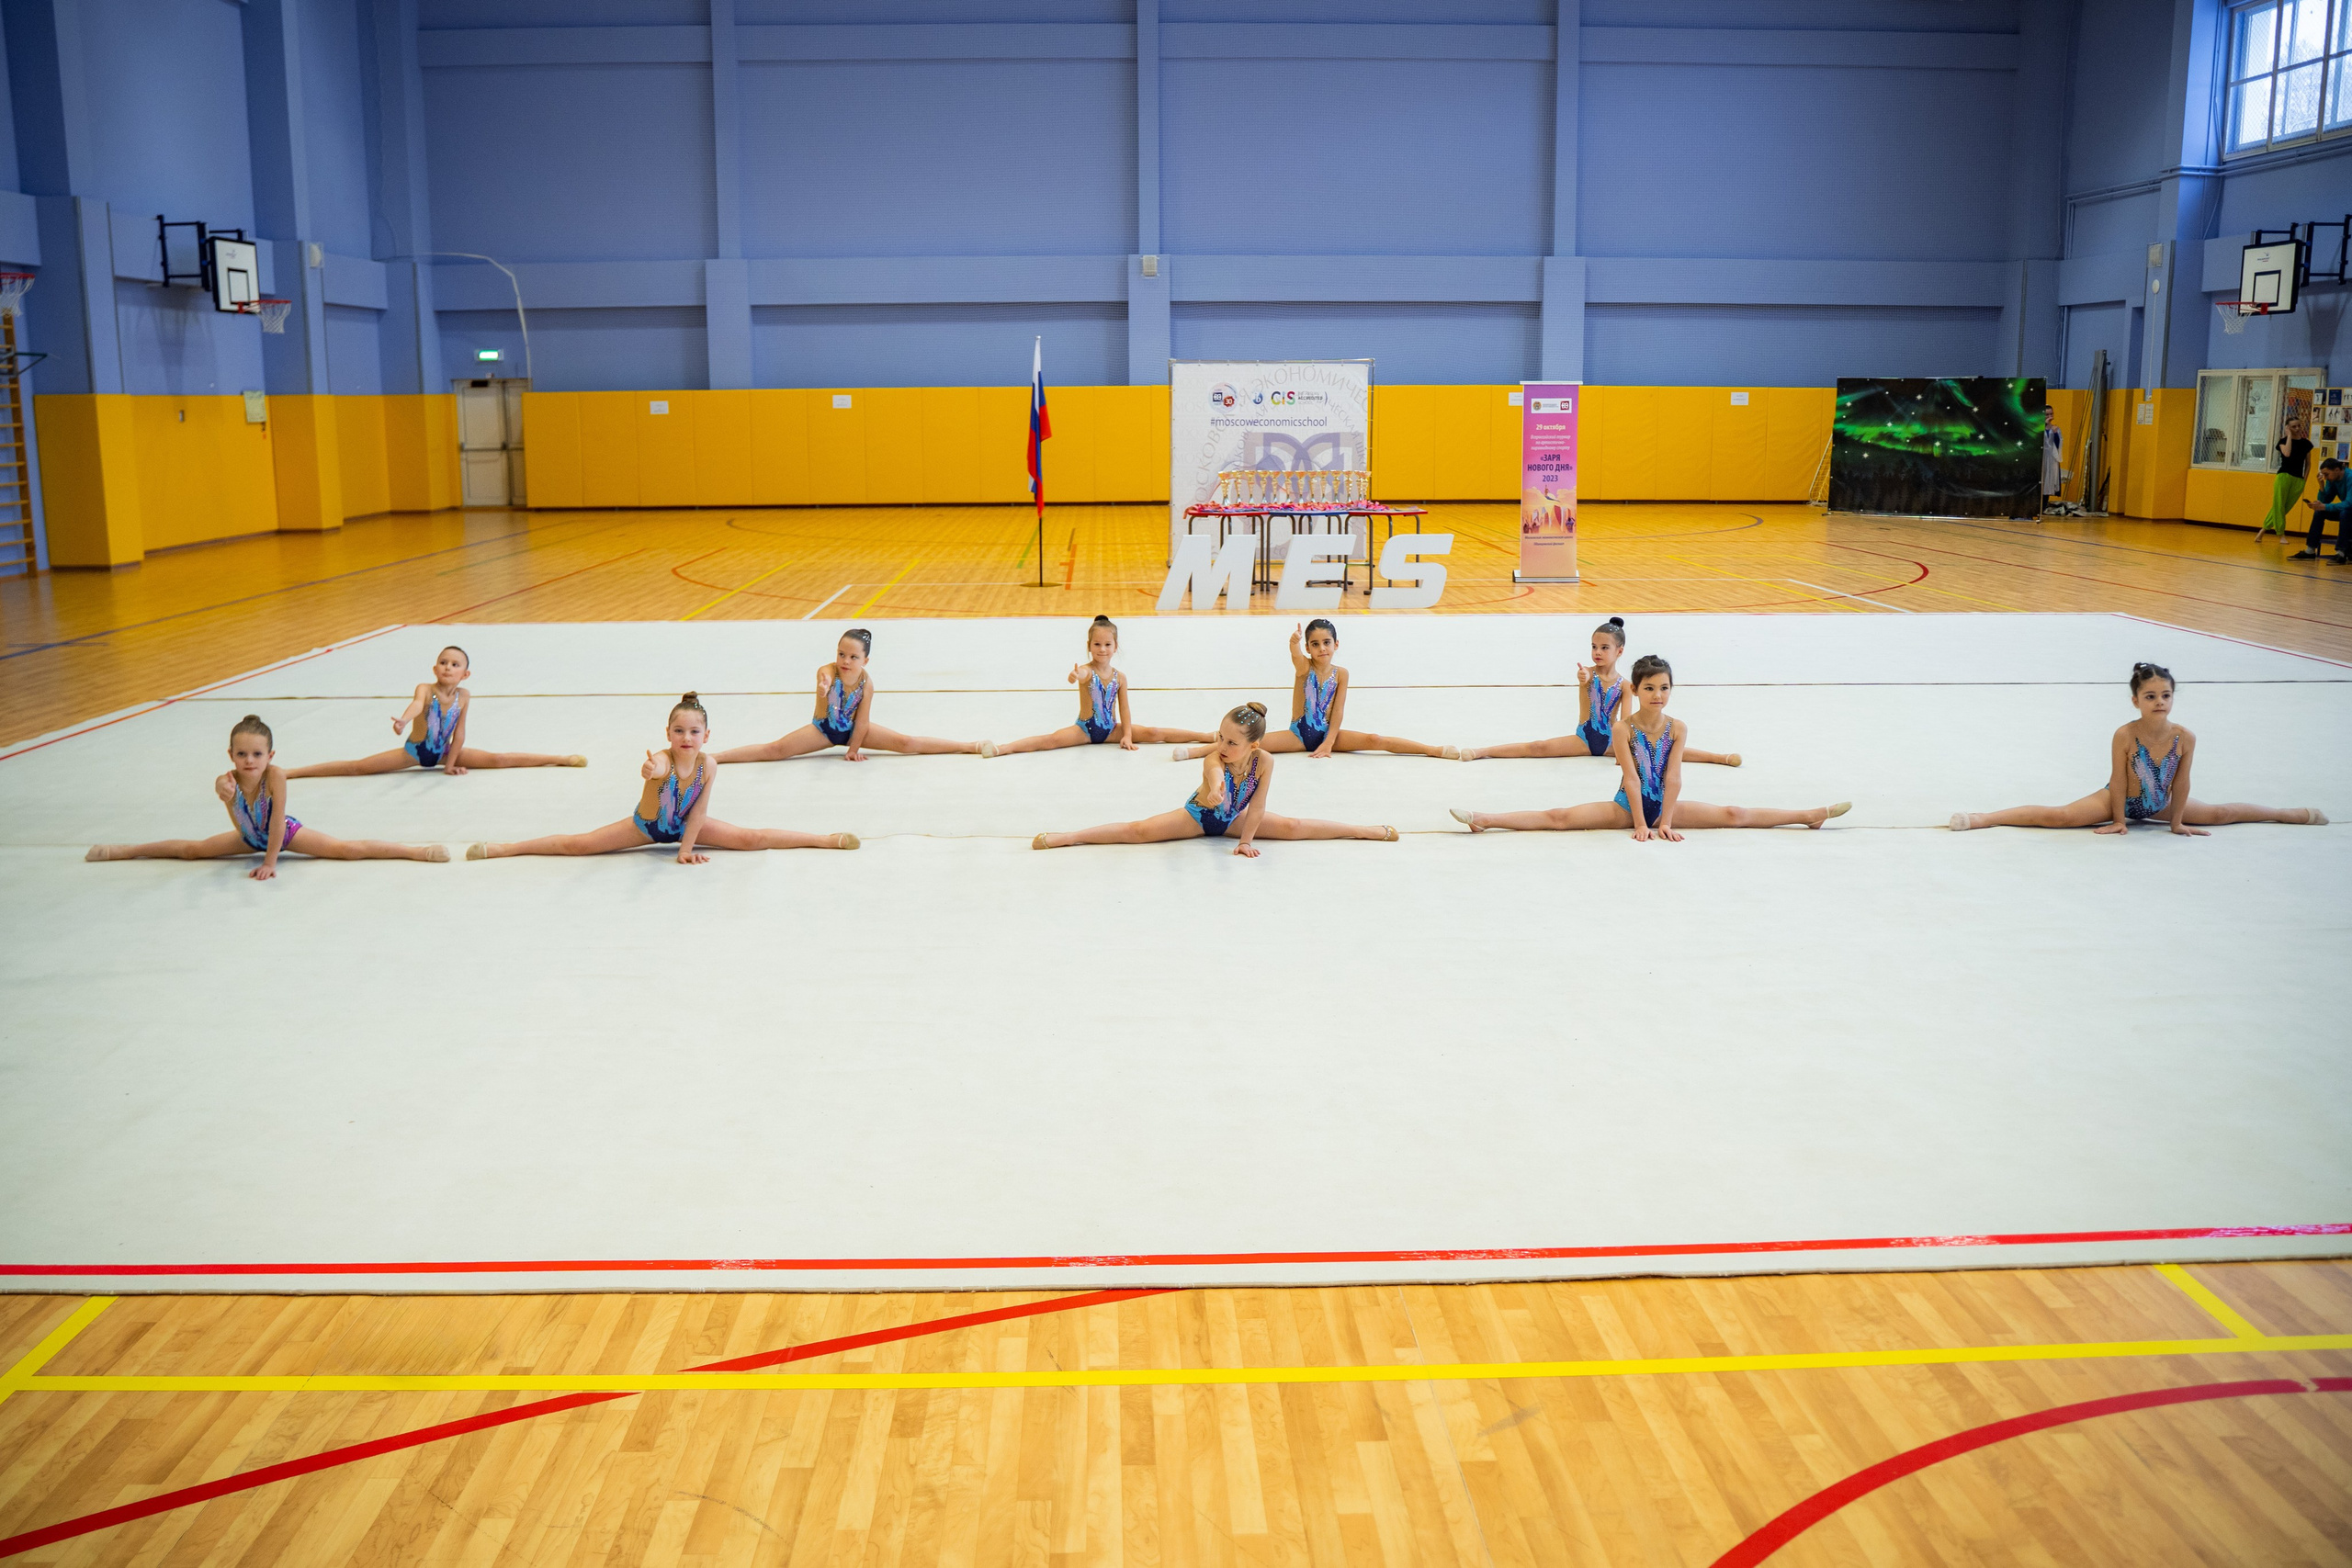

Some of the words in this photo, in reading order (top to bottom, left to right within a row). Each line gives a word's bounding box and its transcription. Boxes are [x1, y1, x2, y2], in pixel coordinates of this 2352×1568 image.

[1210, 416, 1328, 427] #moscoweconomicschool
[1544, 423, 1566, 432] октября
[1555, 463, 1573, 472] ДНЯ»
[1542, 474, 1558, 482] 2023
[1155, 534, 1454, 611] MES
